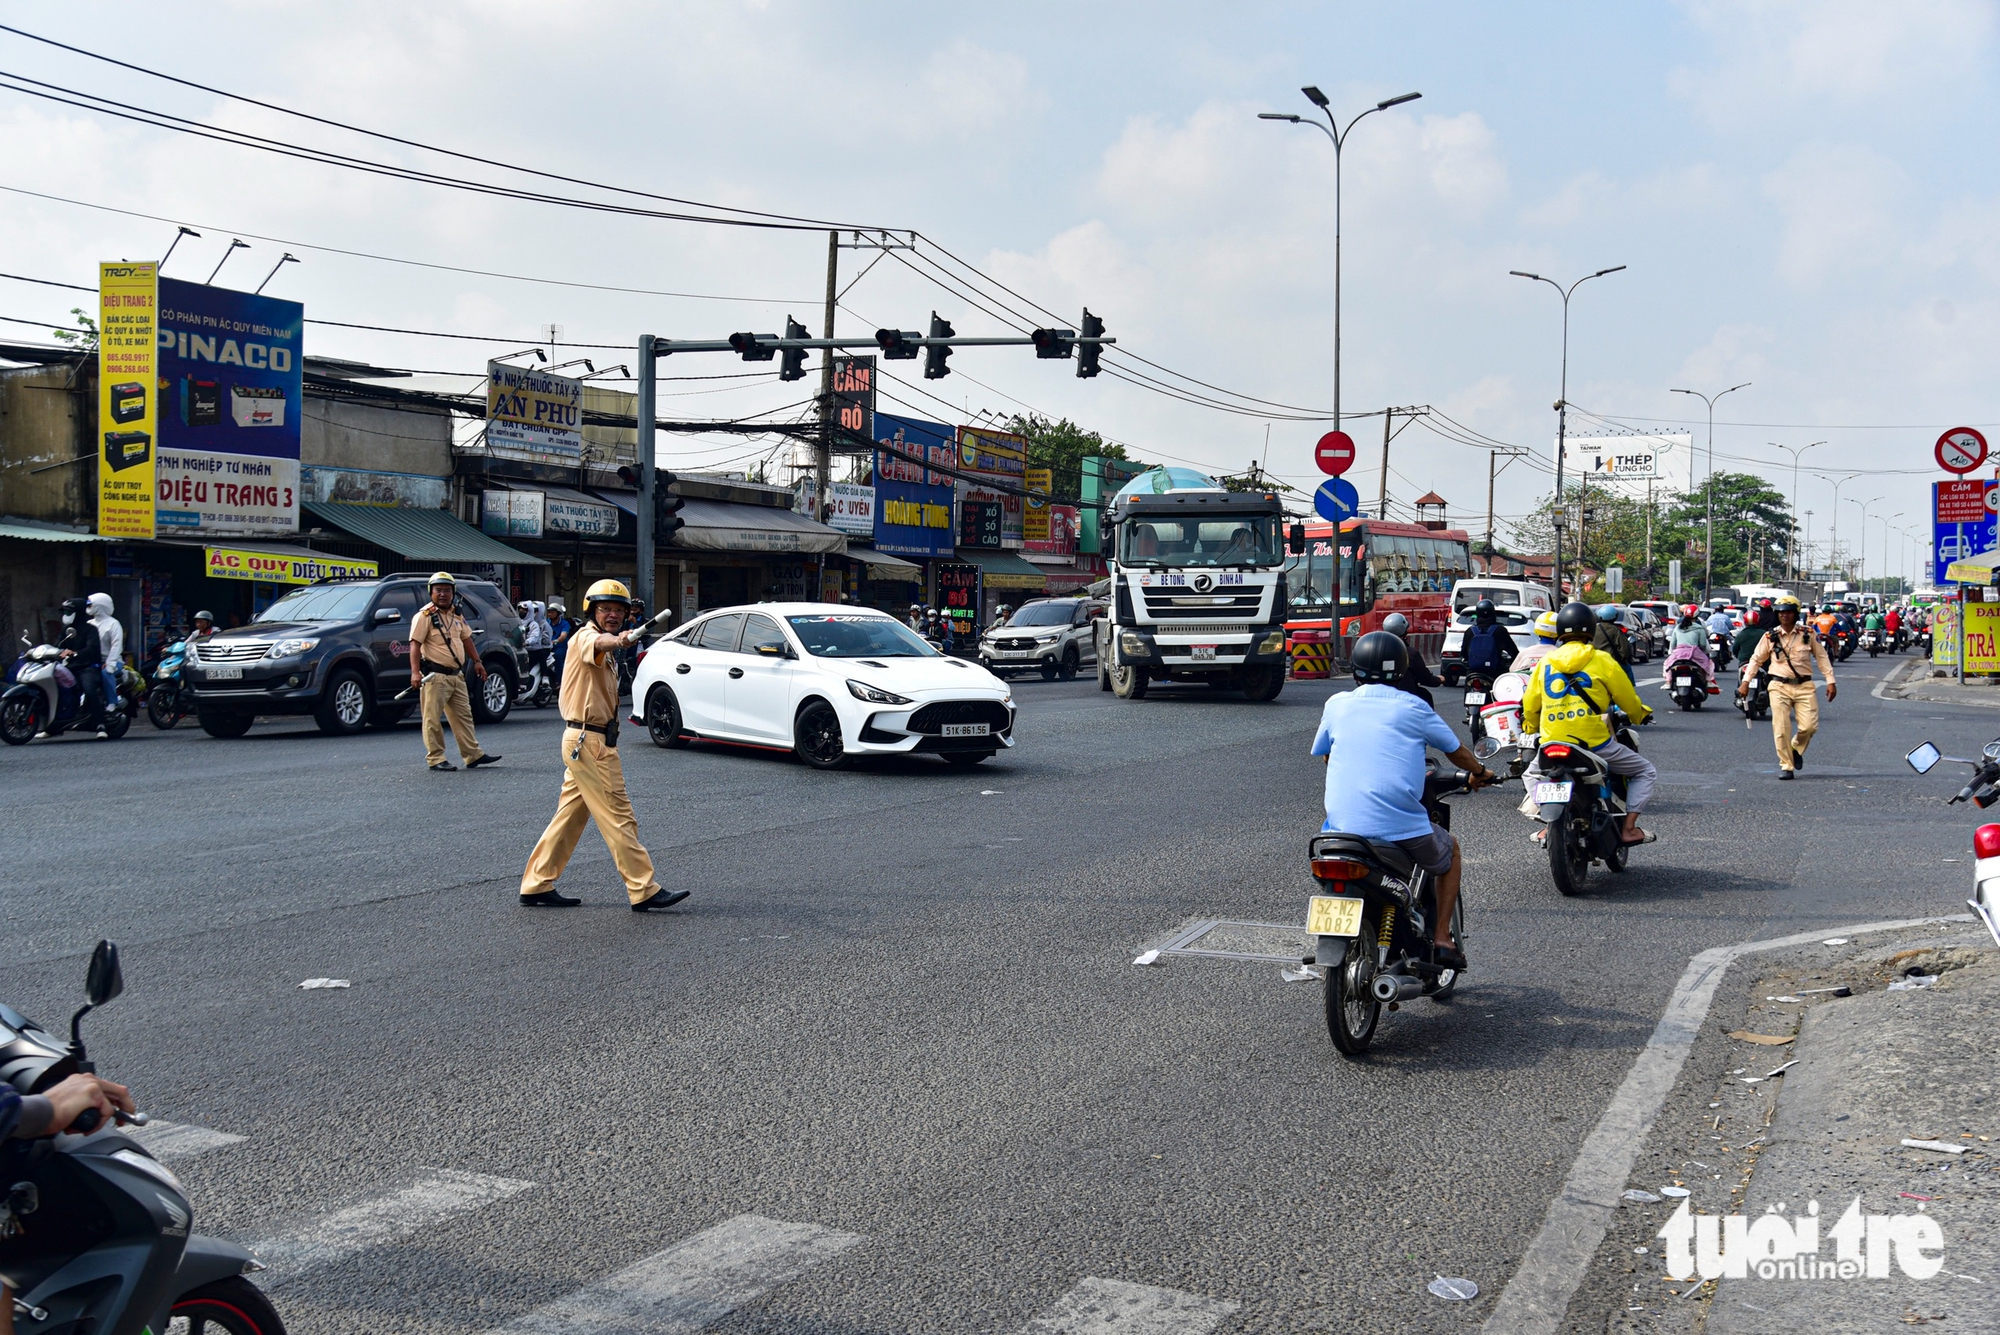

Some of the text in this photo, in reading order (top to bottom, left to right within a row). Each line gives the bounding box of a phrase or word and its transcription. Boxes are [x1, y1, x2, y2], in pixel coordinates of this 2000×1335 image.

[104, 268, 137, 277] TROY
[104, 293, 153, 310] DIỆU TRANG 2
[203, 316, 217, 328] PIN
[233, 321, 251, 333] QUY
[273, 329, 292, 339] NAM
[158, 329, 291, 372] PINACO
[834, 362, 870, 392] CẦM
[523, 375, 552, 393] THUỐC
[554, 380, 570, 397] TÂY
[492, 393, 577, 426] AN PHÚ
[552, 428, 568, 436] GPP
[183, 458, 223, 474] NGHIỆP
[242, 462, 271, 476] NHÂN
[1616, 453, 1652, 465] THÉP
[1640, 464, 1652, 472] HO
[158, 475, 293, 508] DIỆU TRANG 3
[850, 488, 859, 496] GIA
[487, 497, 500, 513] NHÀ
[526, 500, 539, 514] TÂY
[550, 503, 602, 518] NHÀ THUỐC TÂY
[884, 496, 921, 526] HOÀNG
[922, 500, 949, 528] TÙNG
[551, 518, 570, 529] AN
[575, 520, 601, 532] PHÚ
[985, 522, 996, 531] SỐ
[982, 534, 998, 545] CÀO
[249, 558, 289, 571] QUY
[292, 558, 326, 583] DIỆU
[1966, 626, 1996, 657] TRÀ
[1968, 659, 1977, 670] TÂN
[1544, 664, 1592, 699] be
[946, 726, 986, 735] 51K-861.56
[1380, 875, 1405, 891] Wave
[1317, 900, 1355, 916] 52-N2
[1315, 917, 1353, 933] 4082
